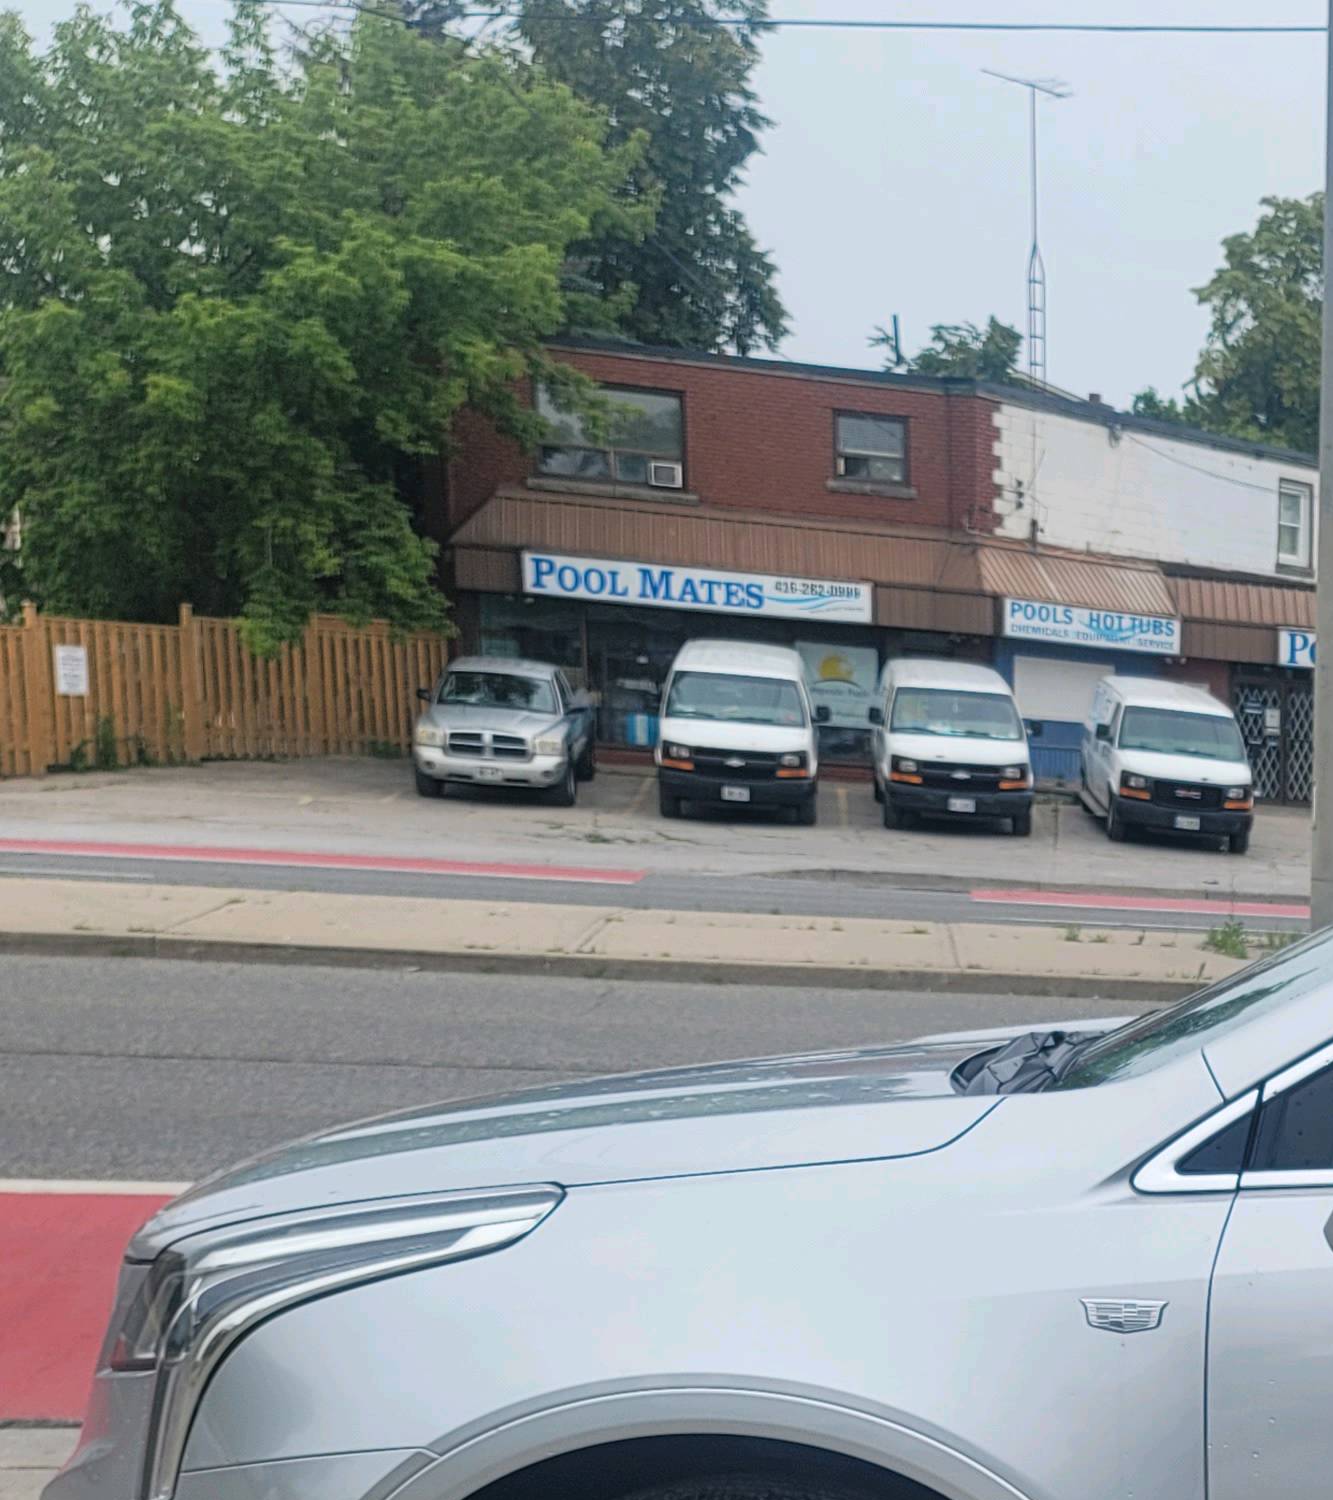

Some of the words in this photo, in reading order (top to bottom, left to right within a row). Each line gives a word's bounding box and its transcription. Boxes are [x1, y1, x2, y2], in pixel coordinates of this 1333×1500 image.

[531, 557, 629, 597] POOL
[638, 567, 765, 609] MATES
[1010, 602, 1073, 624] POOLS
[1089, 611, 1123, 631] HOT
[1129, 616, 1175, 637] TUBS
